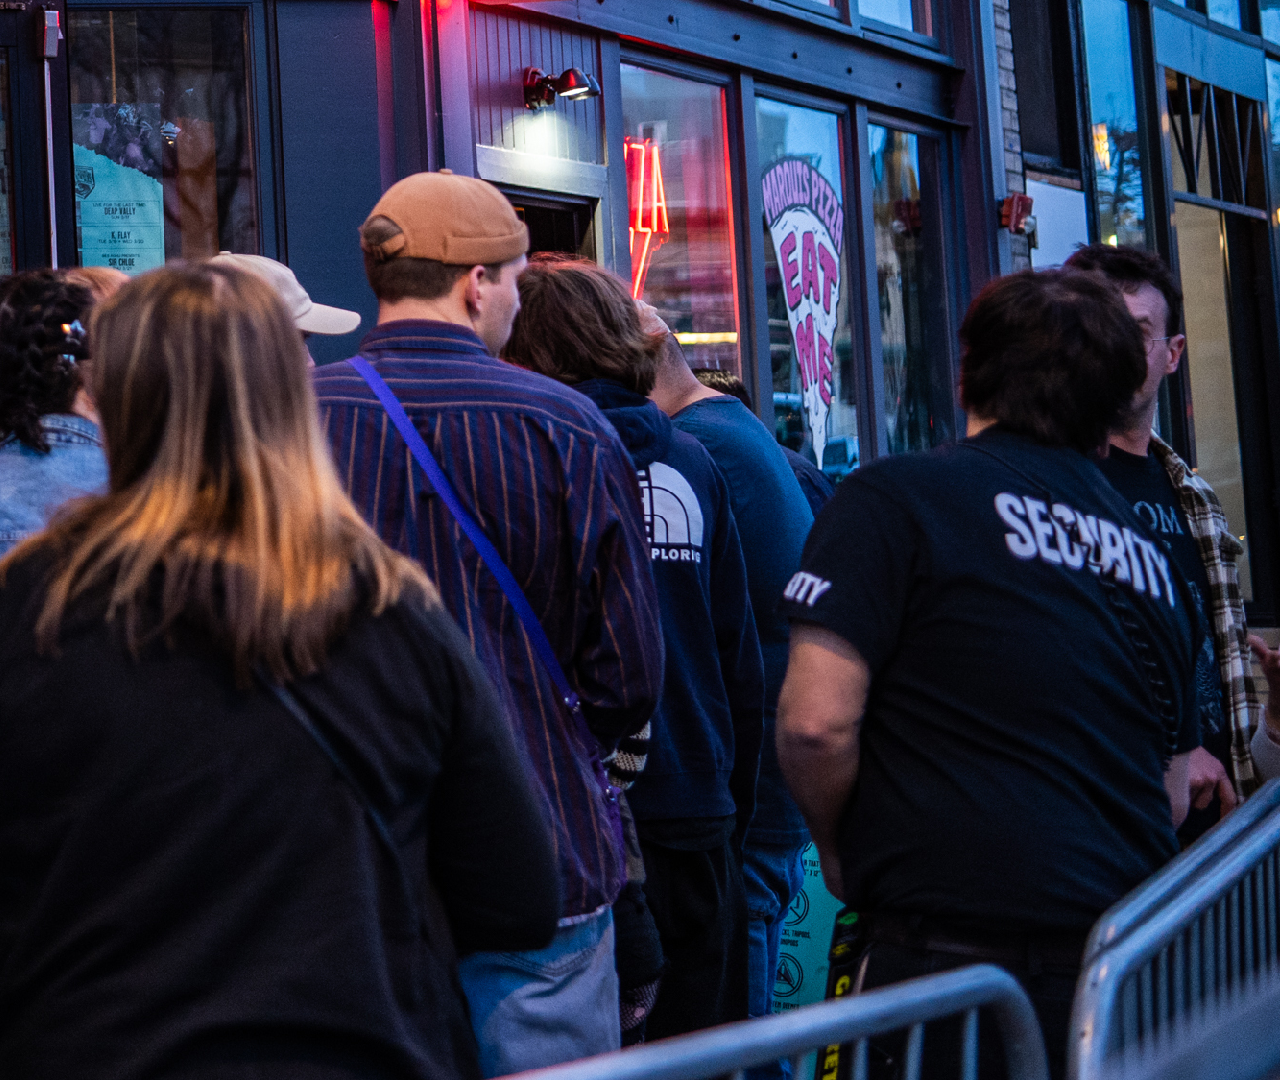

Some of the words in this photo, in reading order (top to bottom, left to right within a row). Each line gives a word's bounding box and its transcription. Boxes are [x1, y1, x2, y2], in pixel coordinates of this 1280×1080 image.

[104, 207, 118, 216] DEAP
[119, 207, 136, 216] VALLY
[762, 159, 811, 226] MARQUIS
[810, 168, 844, 257] PIZZA
[108, 258, 117, 267] SIR
[118, 258, 135, 267] CHLOE
[780, 230, 838, 316] EAT
[796, 313, 834, 407] ME
[993, 491, 1176, 610] SECURITY
